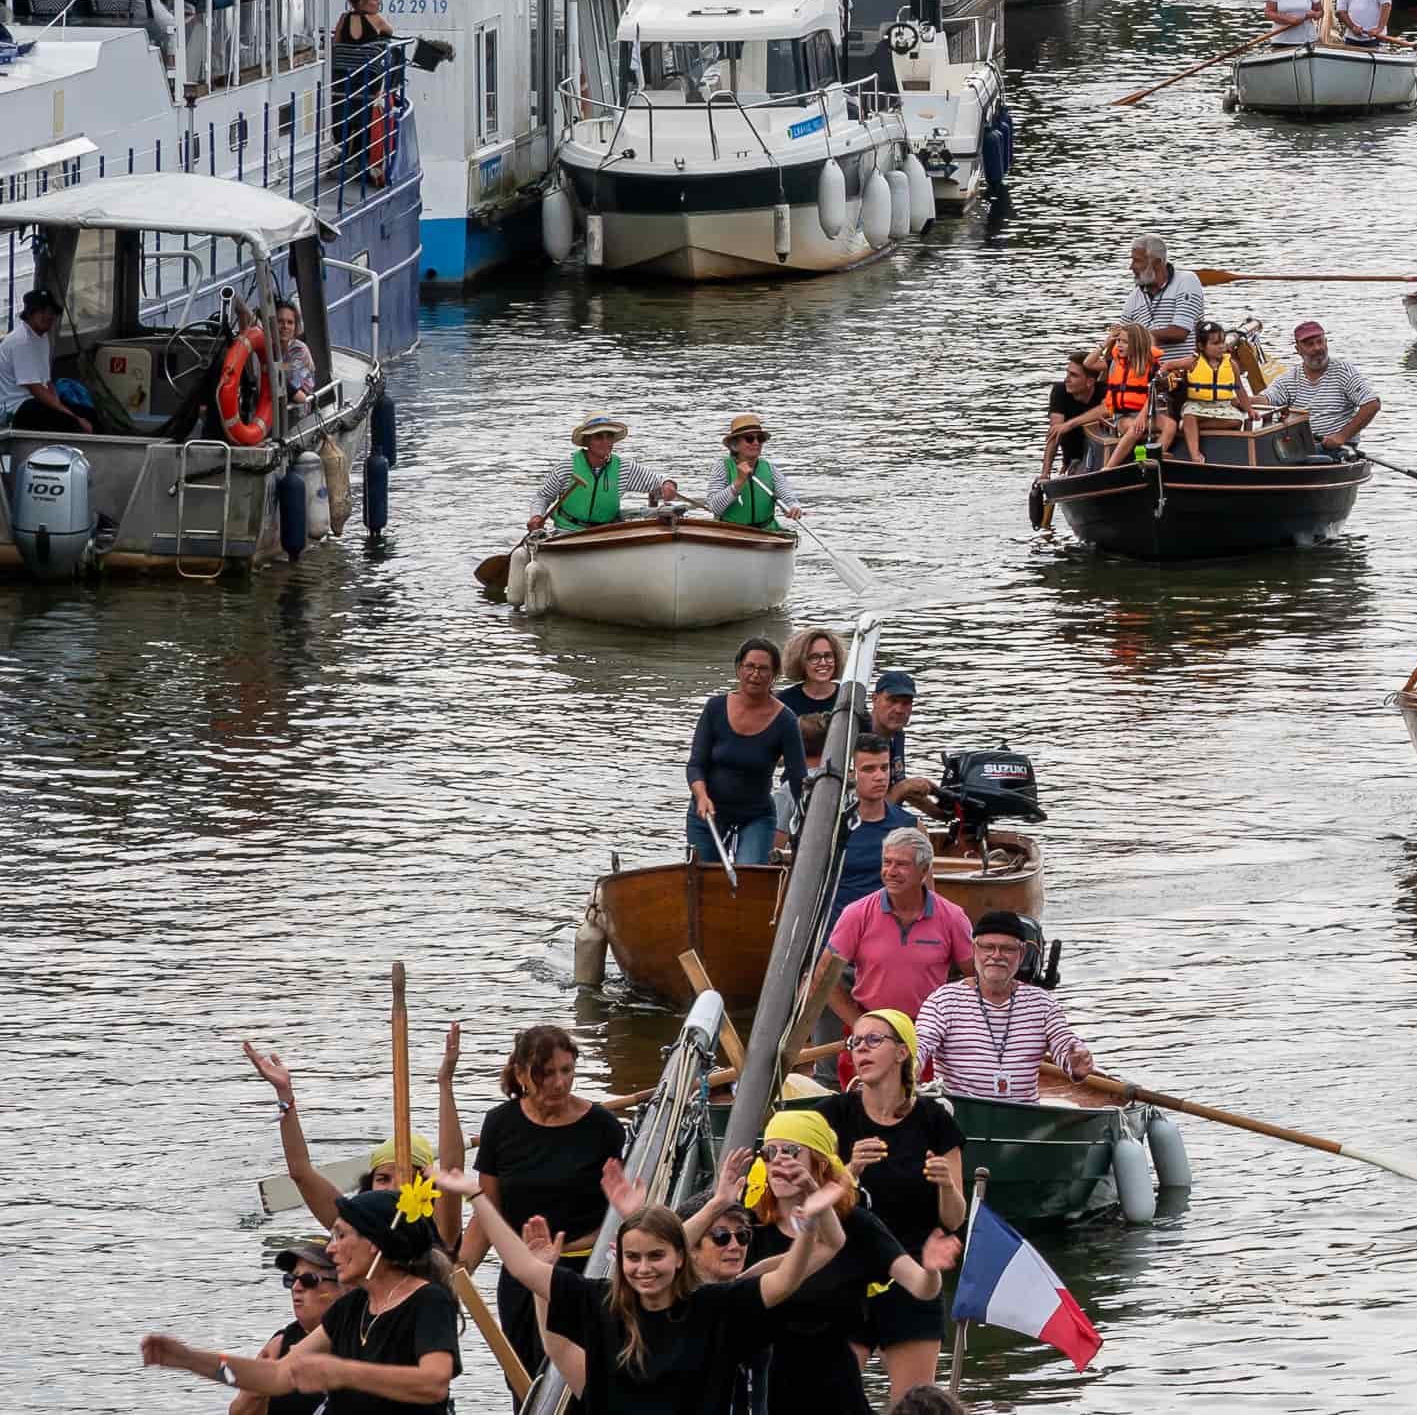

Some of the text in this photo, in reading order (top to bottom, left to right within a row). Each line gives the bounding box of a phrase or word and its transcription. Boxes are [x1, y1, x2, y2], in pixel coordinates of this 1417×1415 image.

[388, 0, 405, 14] 62
[409, 0, 427, 14] 29
[432, 0, 448, 14] 19
[27, 482, 65, 497] 100
[983, 763, 1027, 774] SUZUKI
